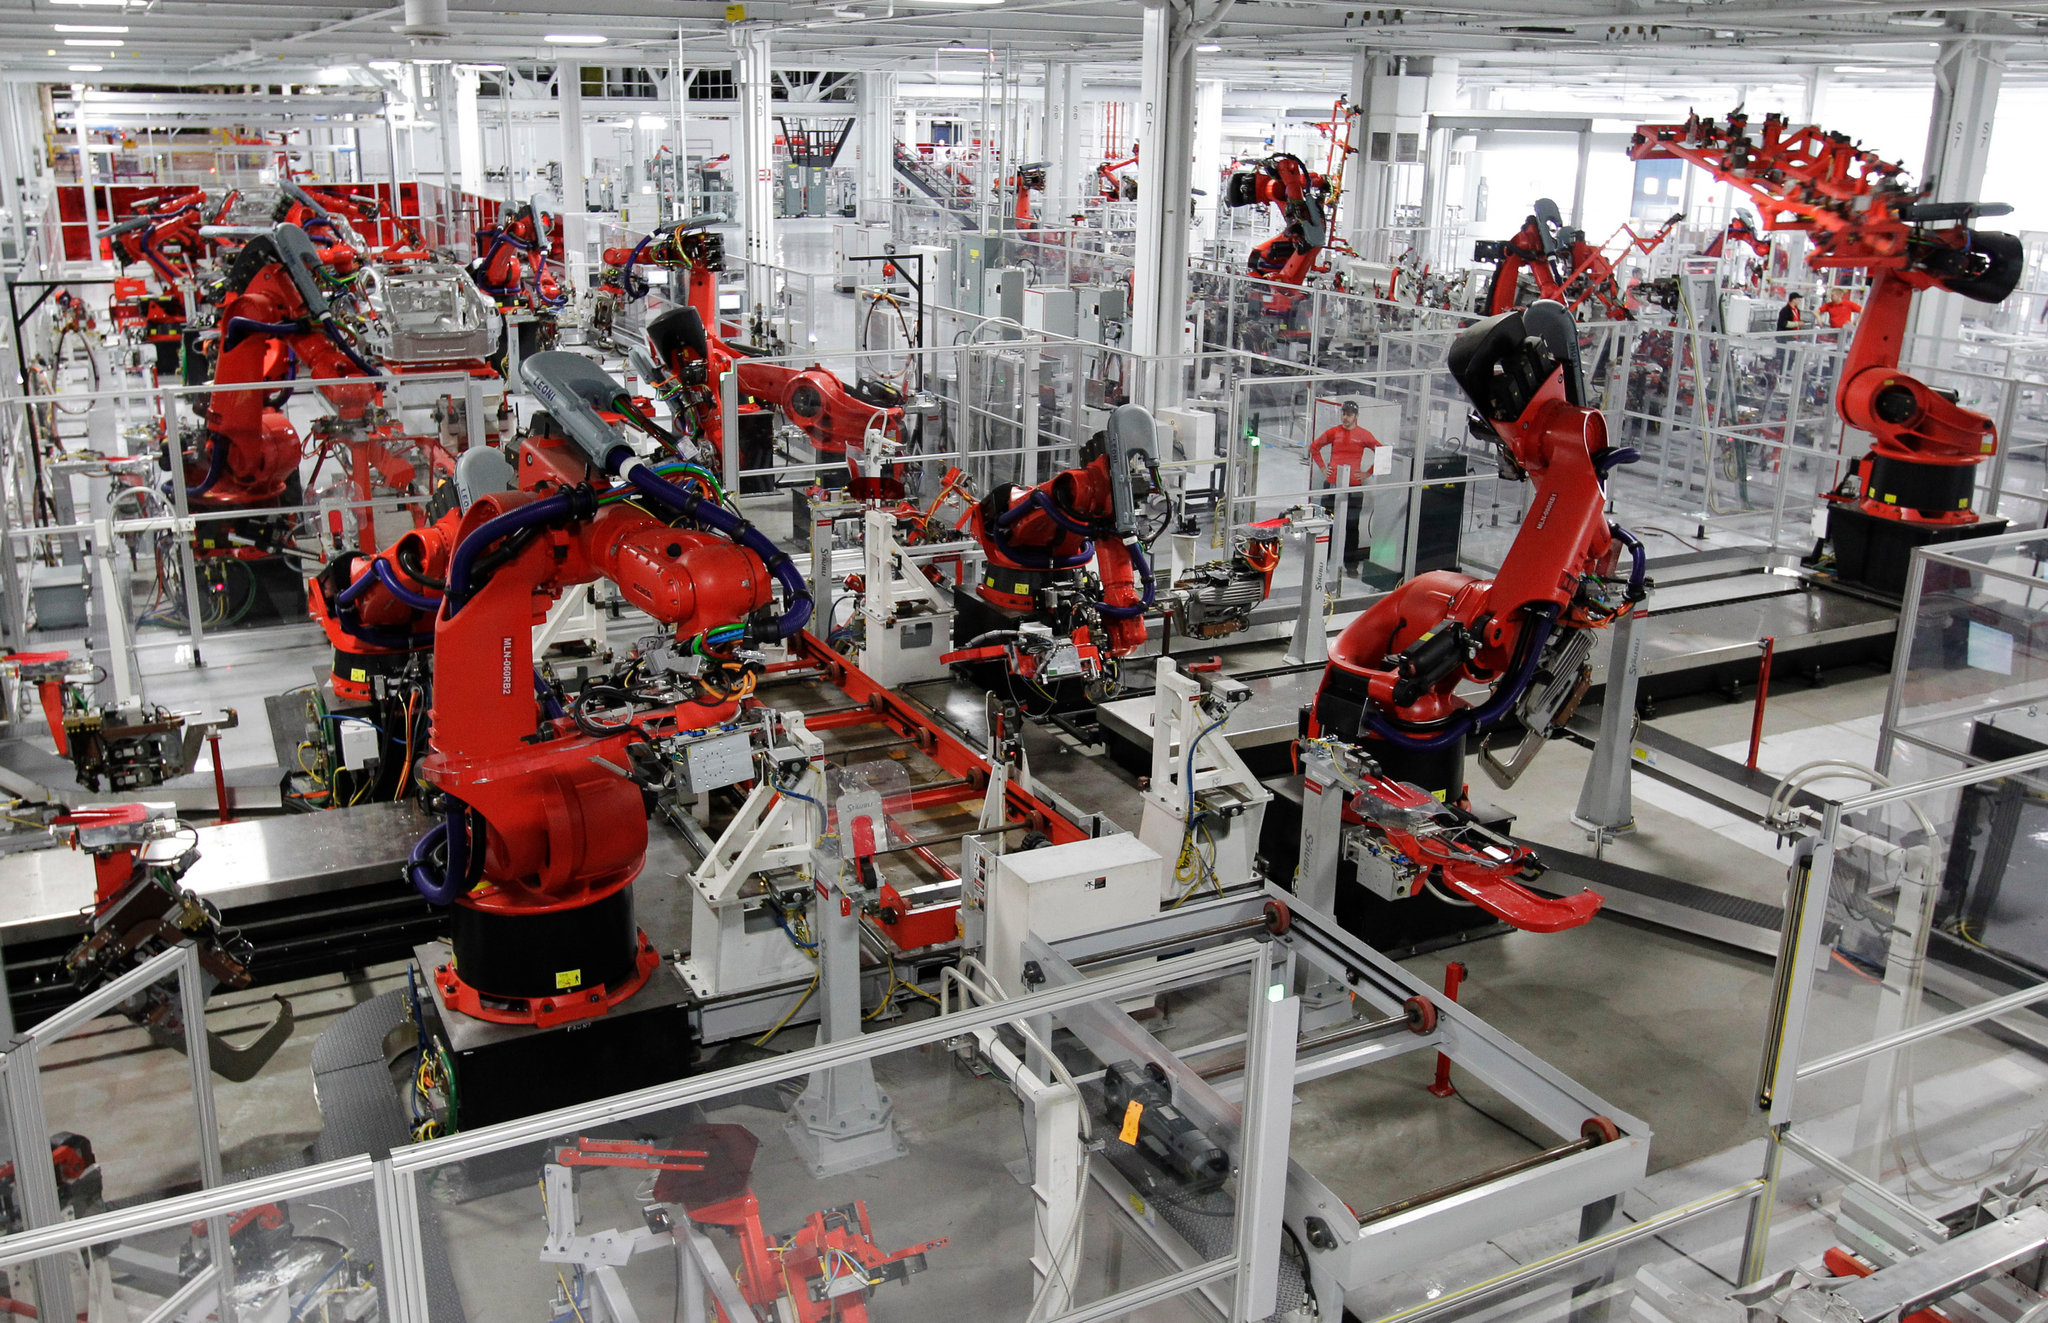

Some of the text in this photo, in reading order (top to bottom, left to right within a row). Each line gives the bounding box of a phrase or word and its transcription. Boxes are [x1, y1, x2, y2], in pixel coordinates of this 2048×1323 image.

[533, 377, 556, 401] LEONI
[461, 488, 470, 509] LEO
[503, 637, 512, 695] MLN-060RB2
